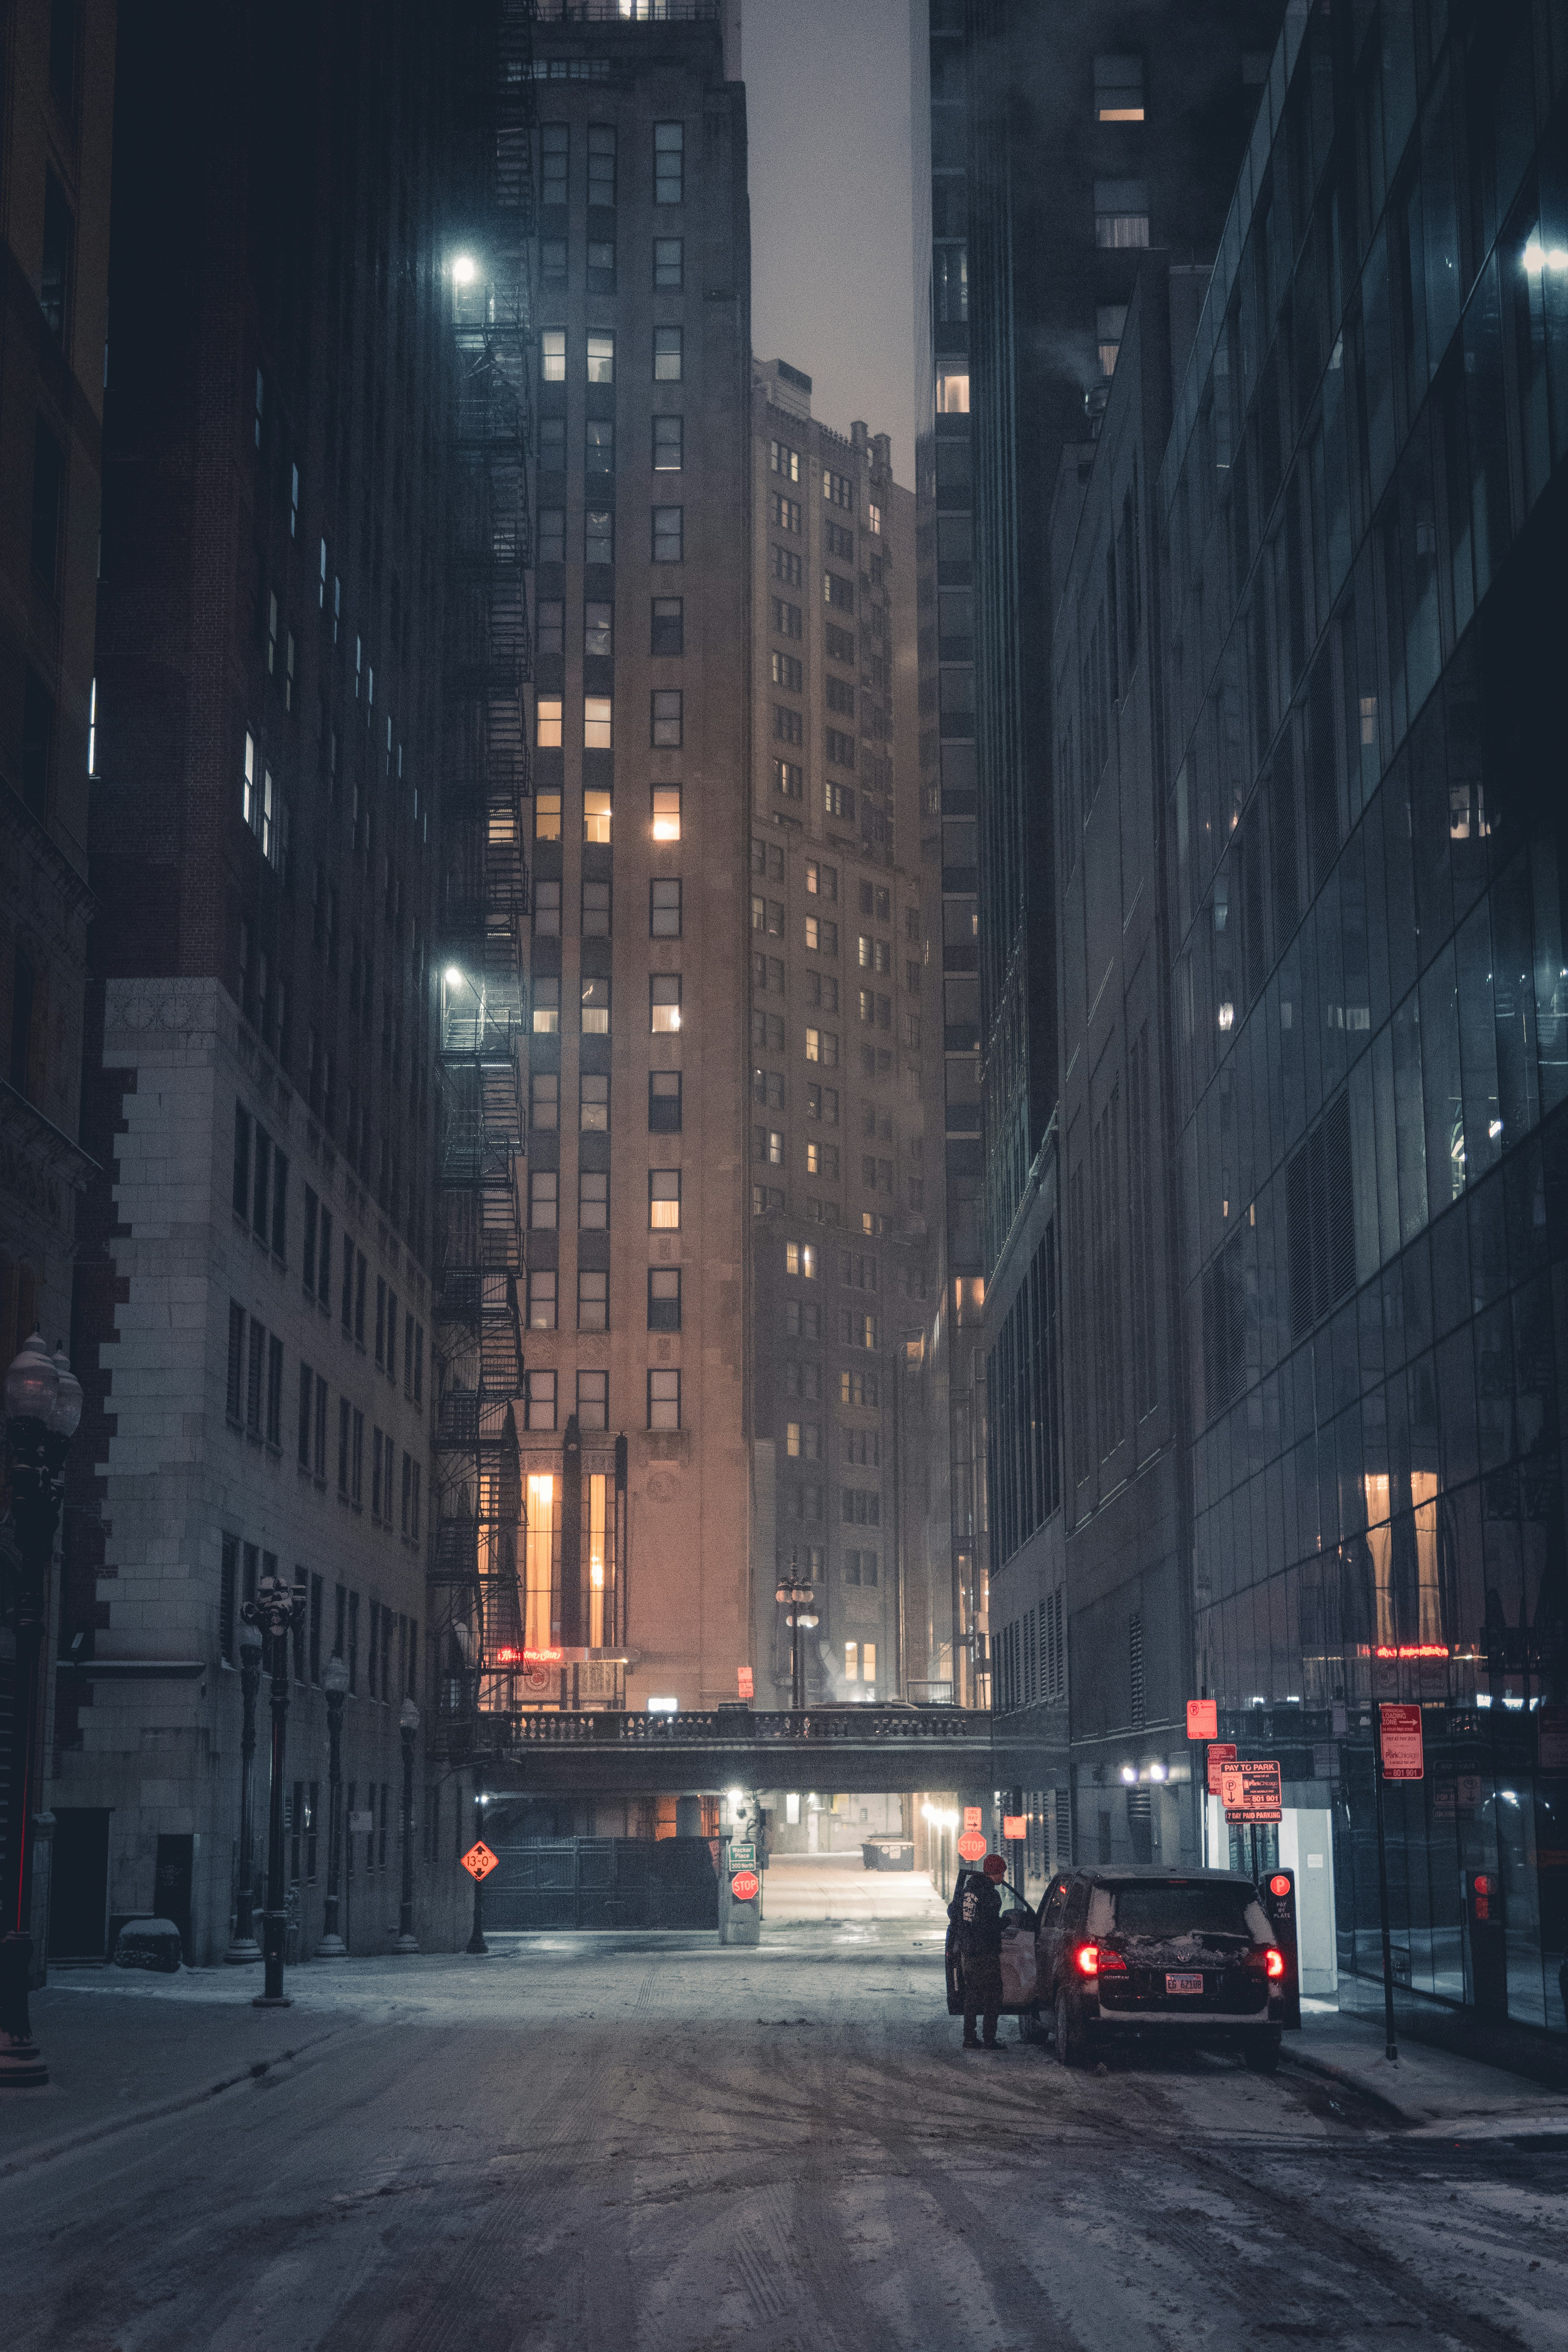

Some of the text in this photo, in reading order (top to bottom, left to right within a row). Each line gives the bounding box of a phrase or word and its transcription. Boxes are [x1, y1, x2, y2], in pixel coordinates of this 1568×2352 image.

[540, 1650, 560, 1661] Inn
[960, 1841, 984, 1852] STOP
[467, 1856, 492, 1866] 13'-0"
[734, 1880, 756, 1892] STOP
[1168, 1980, 1176, 1989] EG
